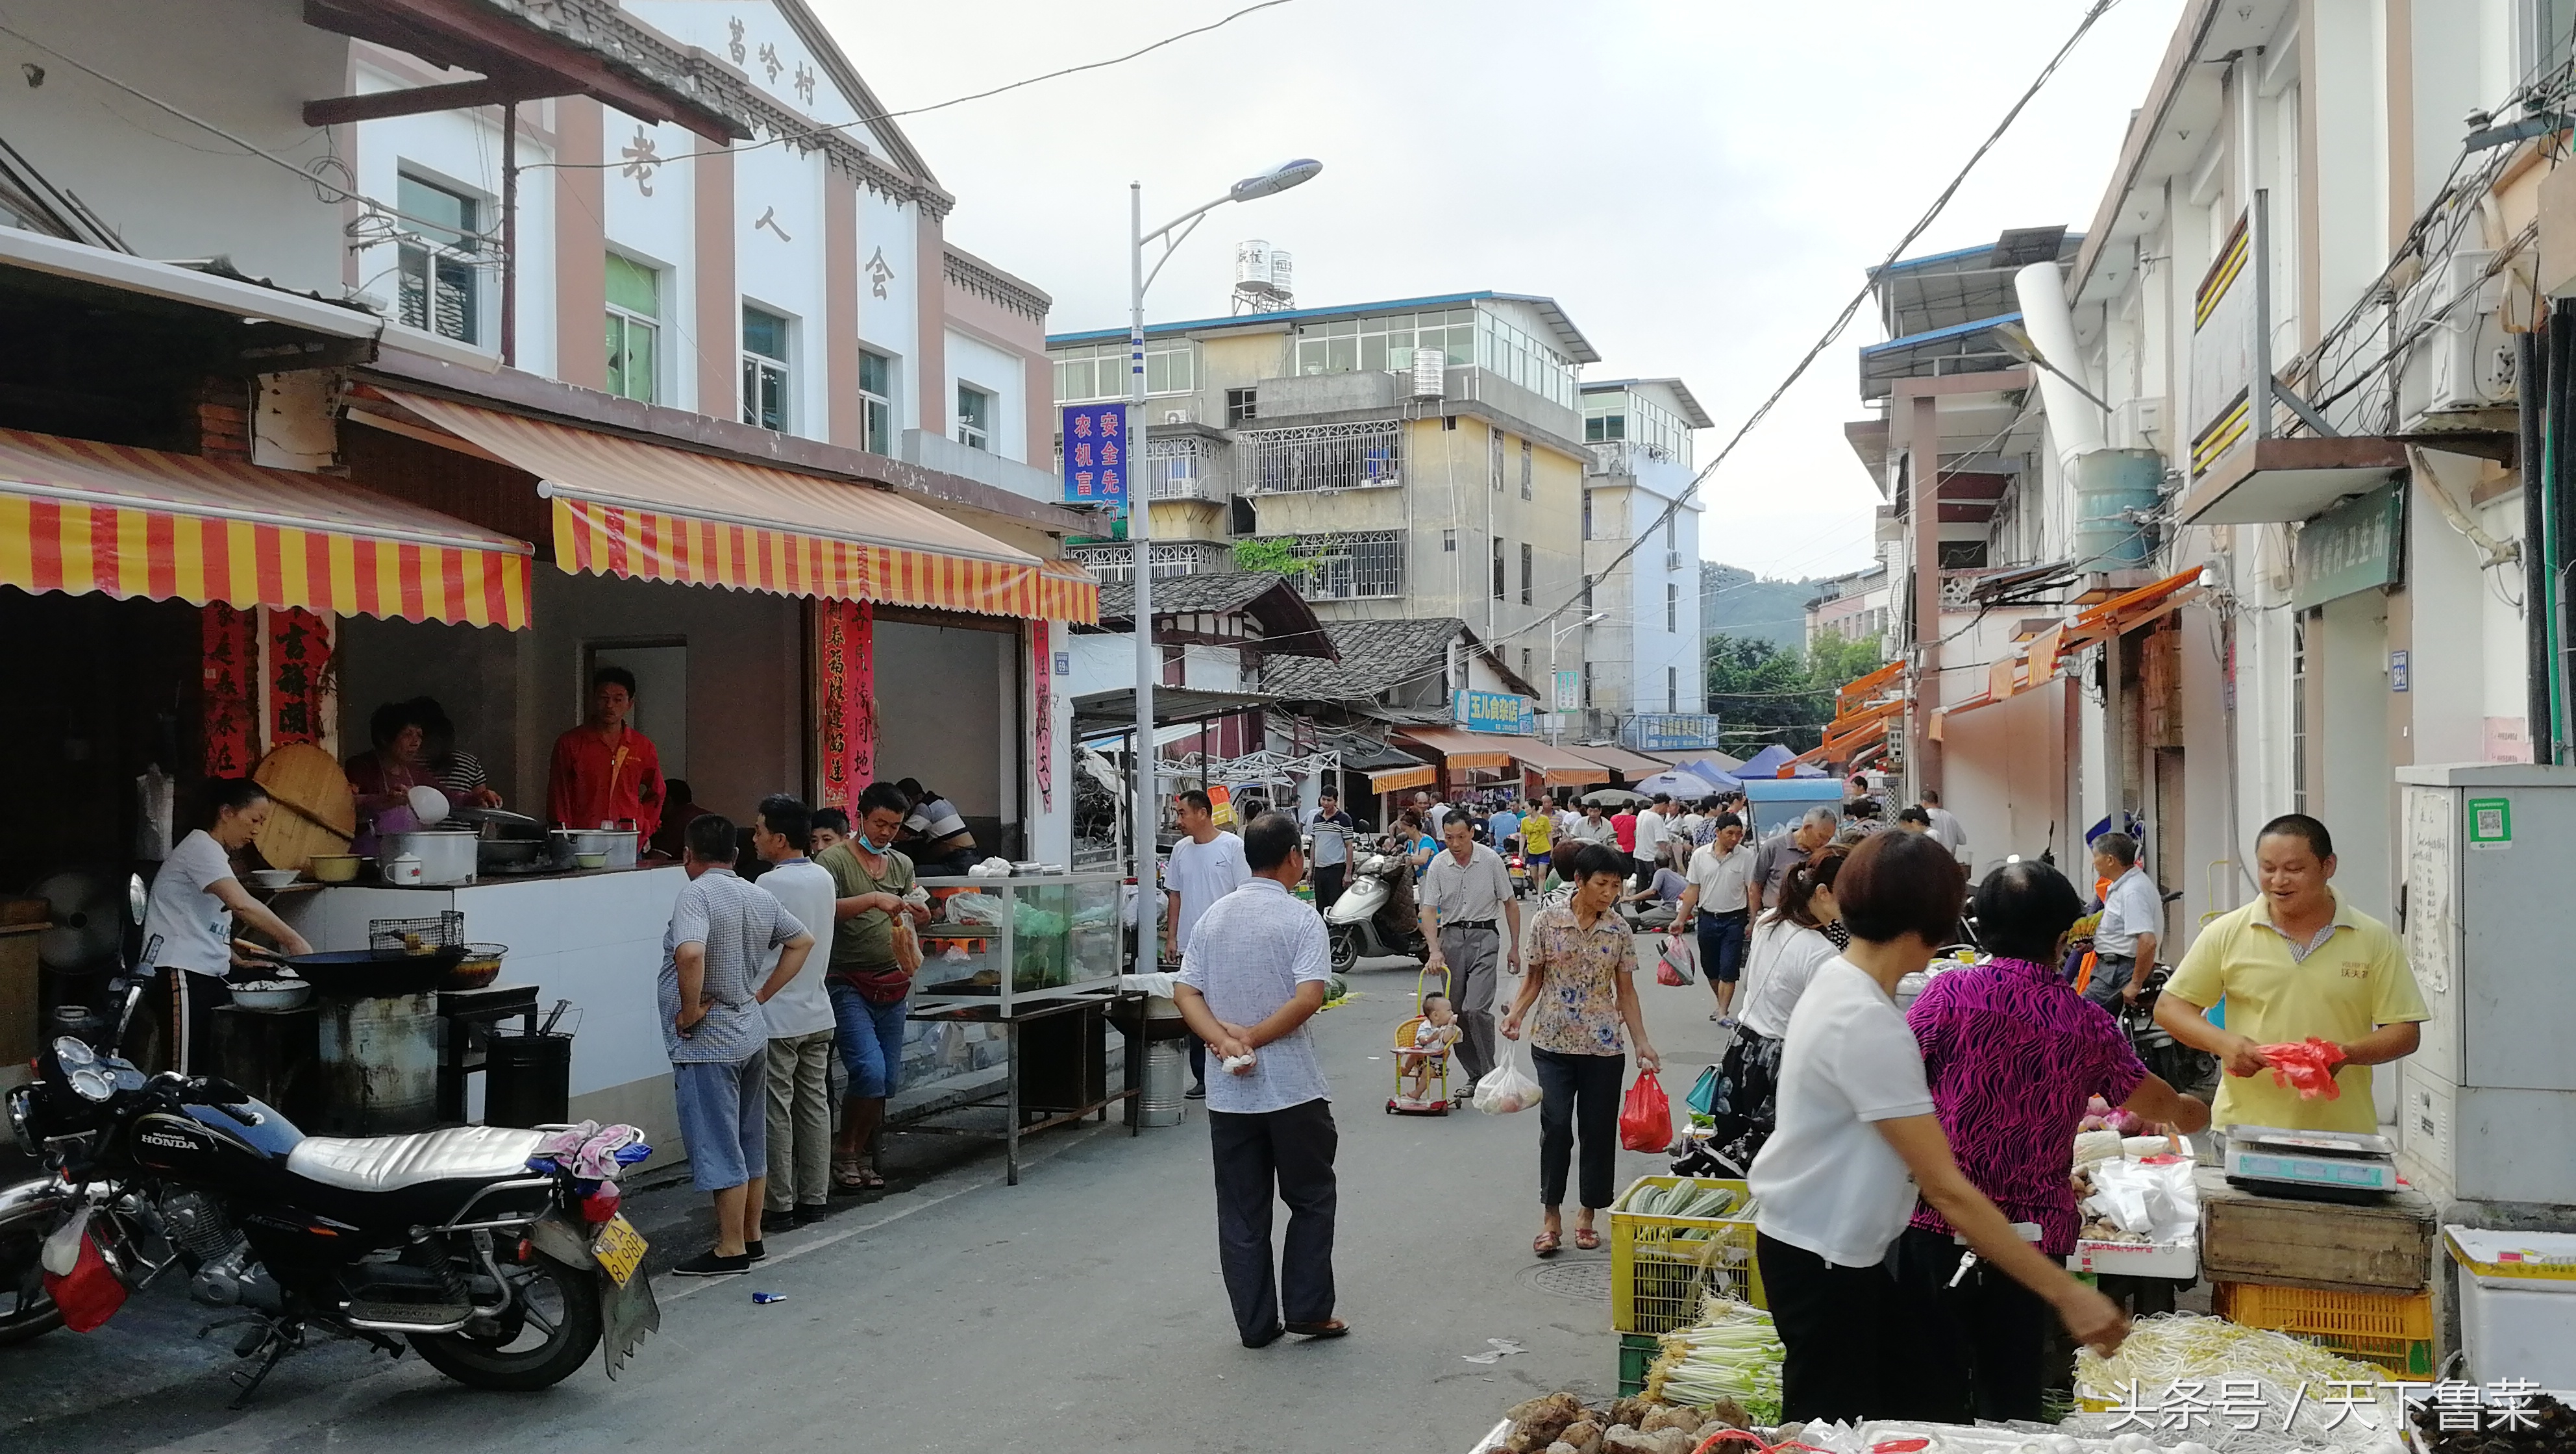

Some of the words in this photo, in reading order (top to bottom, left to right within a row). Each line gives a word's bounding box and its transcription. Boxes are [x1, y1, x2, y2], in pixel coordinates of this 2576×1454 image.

[728, 14, 815, 106] 葛岭村
[1074, 413, 1093, 497] 农机富
[1100, 412, 1120, 523] 安全先行
[141, 1134, 199, 1150] HONDA
[612, 1232, 643, 1283] 8198P
